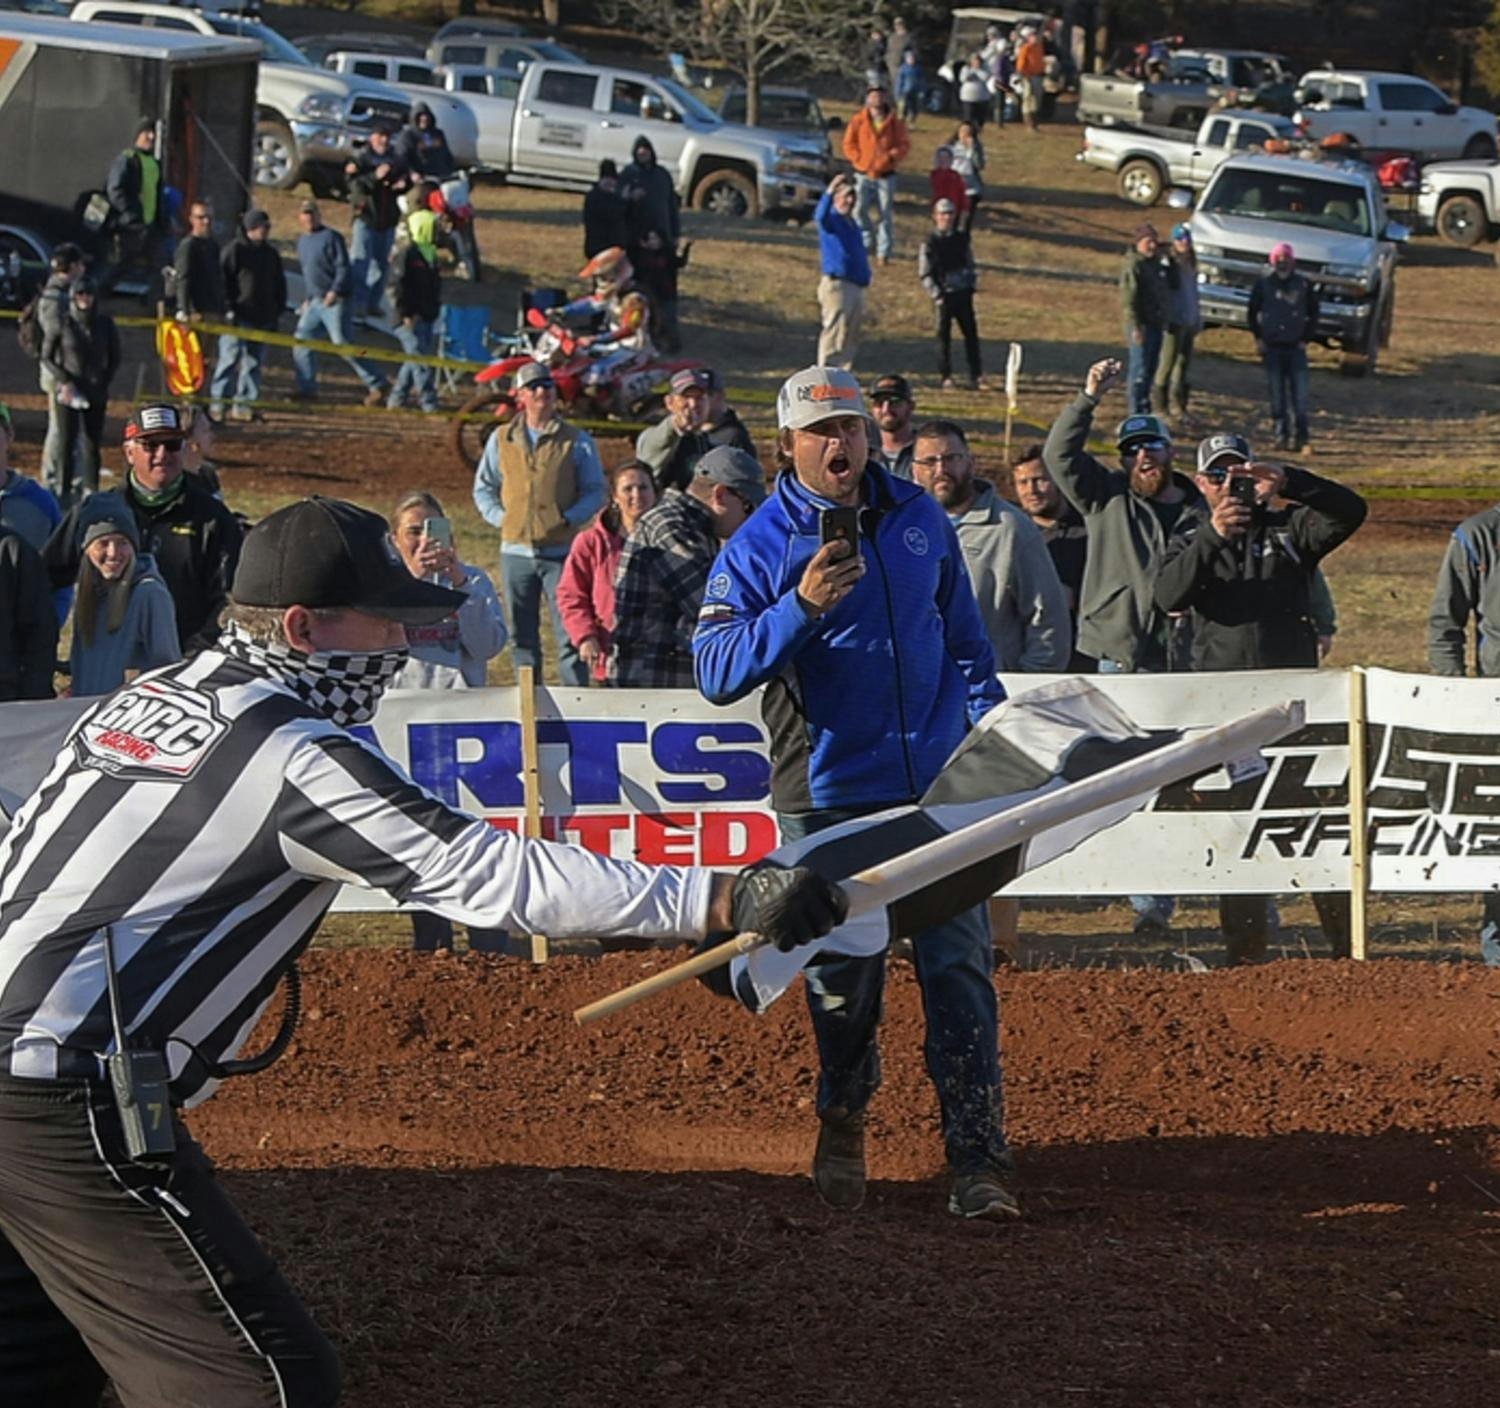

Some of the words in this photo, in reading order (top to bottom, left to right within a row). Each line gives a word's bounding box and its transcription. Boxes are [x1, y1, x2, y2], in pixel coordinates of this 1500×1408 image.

[90, 692, 215, 755] GNCC
[95, 730, 160, 762] RACING
[147, 1103, 162, 1130] 7
